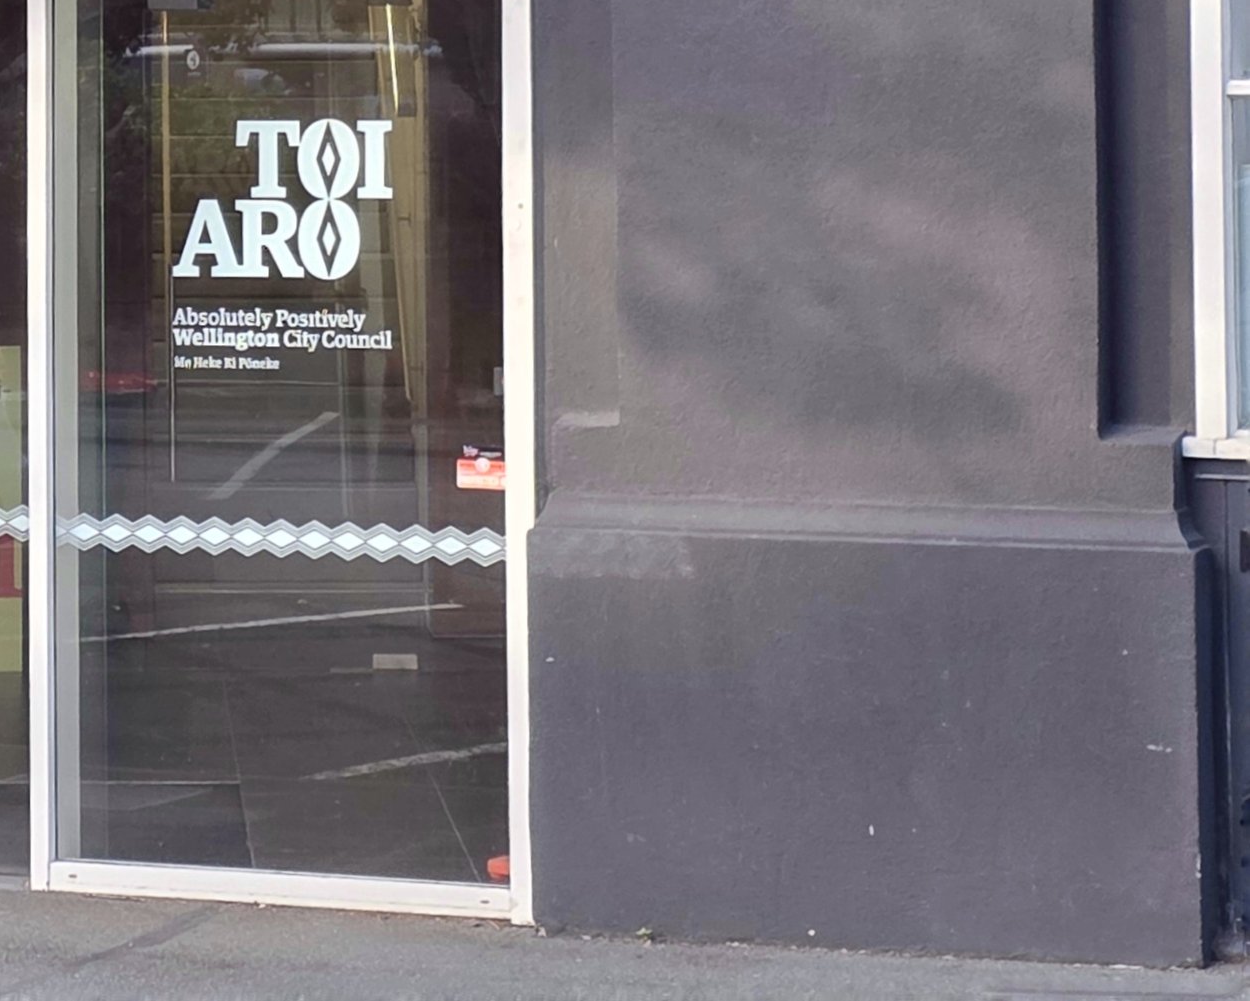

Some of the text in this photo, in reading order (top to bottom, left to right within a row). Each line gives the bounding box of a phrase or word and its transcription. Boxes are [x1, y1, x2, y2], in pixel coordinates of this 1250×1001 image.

[235, 118, 393, 199] TOI
[172, 199, 361, 280] ARO
[172, 307, 366, 332] Absolutely Positively
[172, 328, 392, 352] Wellington City Council
